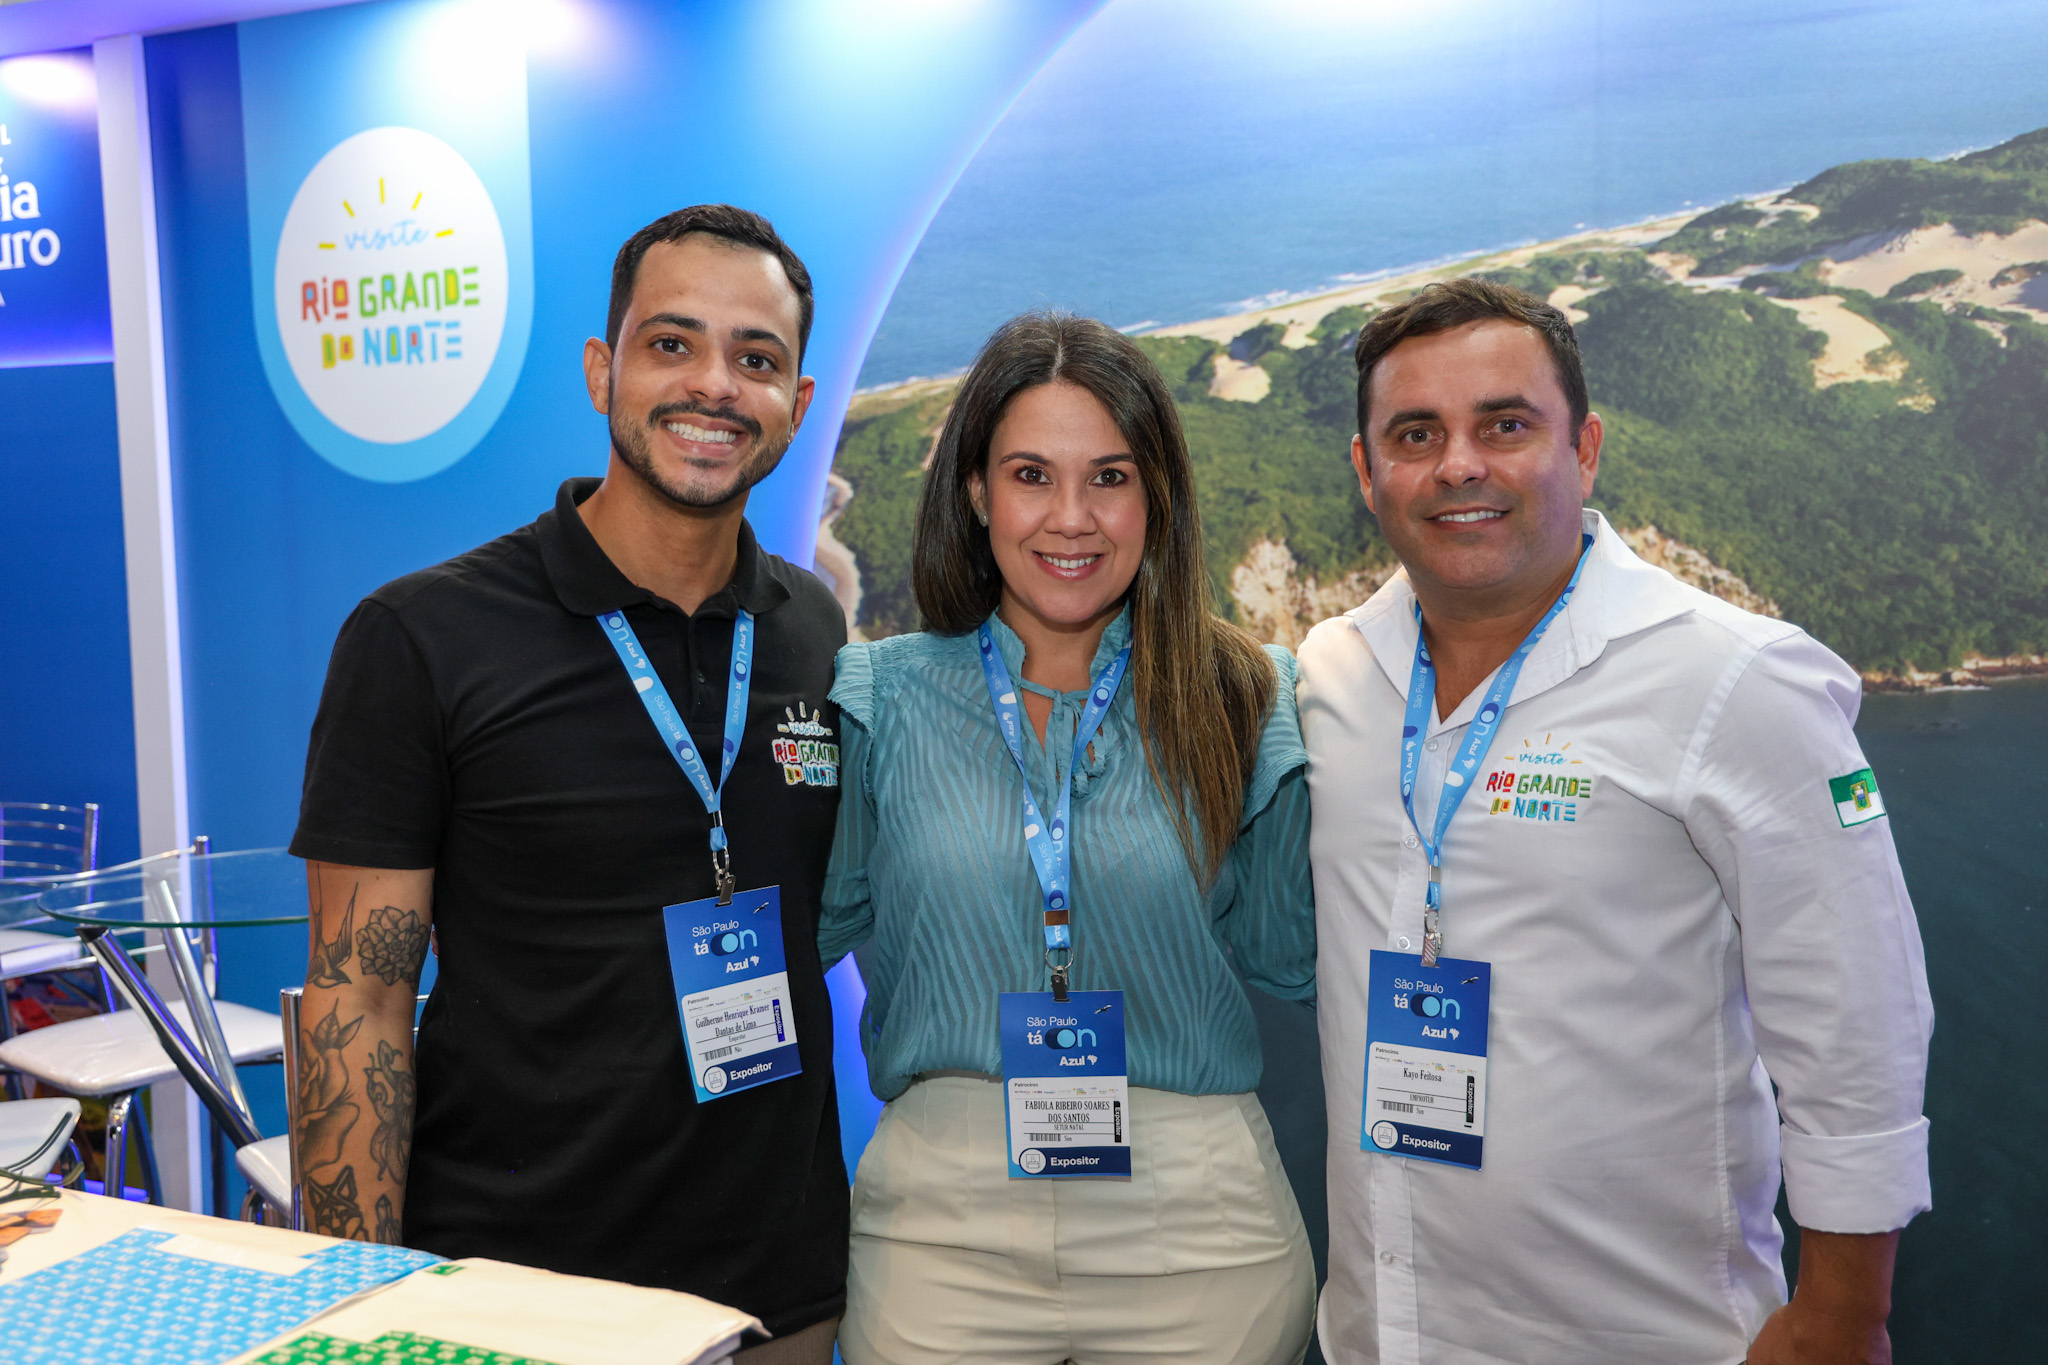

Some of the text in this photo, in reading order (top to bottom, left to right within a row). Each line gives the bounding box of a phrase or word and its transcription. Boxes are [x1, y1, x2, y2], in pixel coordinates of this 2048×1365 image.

[344, 219, 429, 251] visite
[359, 266, 480, 318] GRANDE
[321, 320, 462, 369] DO NORTE
[1519, 752, 1568, 766] visite
[1516, 774, 1592, 799] GRANDE
[1490, 797, 1577, 822] DO NORTE
[692, 919, 740, 938] São Paulo
[694, 939, 709, 956] tá
[726, 958, 749, 973] Azul
[1394, 978, 1444, 994] São Paulo
[1393, 993, 1408, 1009] tá
[696, 1004, 770, 1029] Guilherme Henrique Kramer
[774, 1005, 783, 1034] Expositor
[1026, 1016, 1078, 1027] São Paulo
[715, 1025, 735, 1038] Dantas
[735, 1022, 742, 1032] de
[1027, 1030, 1043, 1045] tá
[1422, 1025, 1447, 1039] Azul
[1059, 1055, 1086, 1067] Azul
[730, 1061, 773, 1081] Expositor
[1403, 1067, 1418, 1080] Kayo
[1420, 1069, 1442, 1082] Feitosa
[1025, 1100, 1110, 1111] FABIOLA RIBEIRO SOARES
[1048, 1113, 1090, 1123] DOS SANTOS
[1402, 1133, 1452, 1152] Expositor
[1050, 1157, 1100, 1168] Expositor
